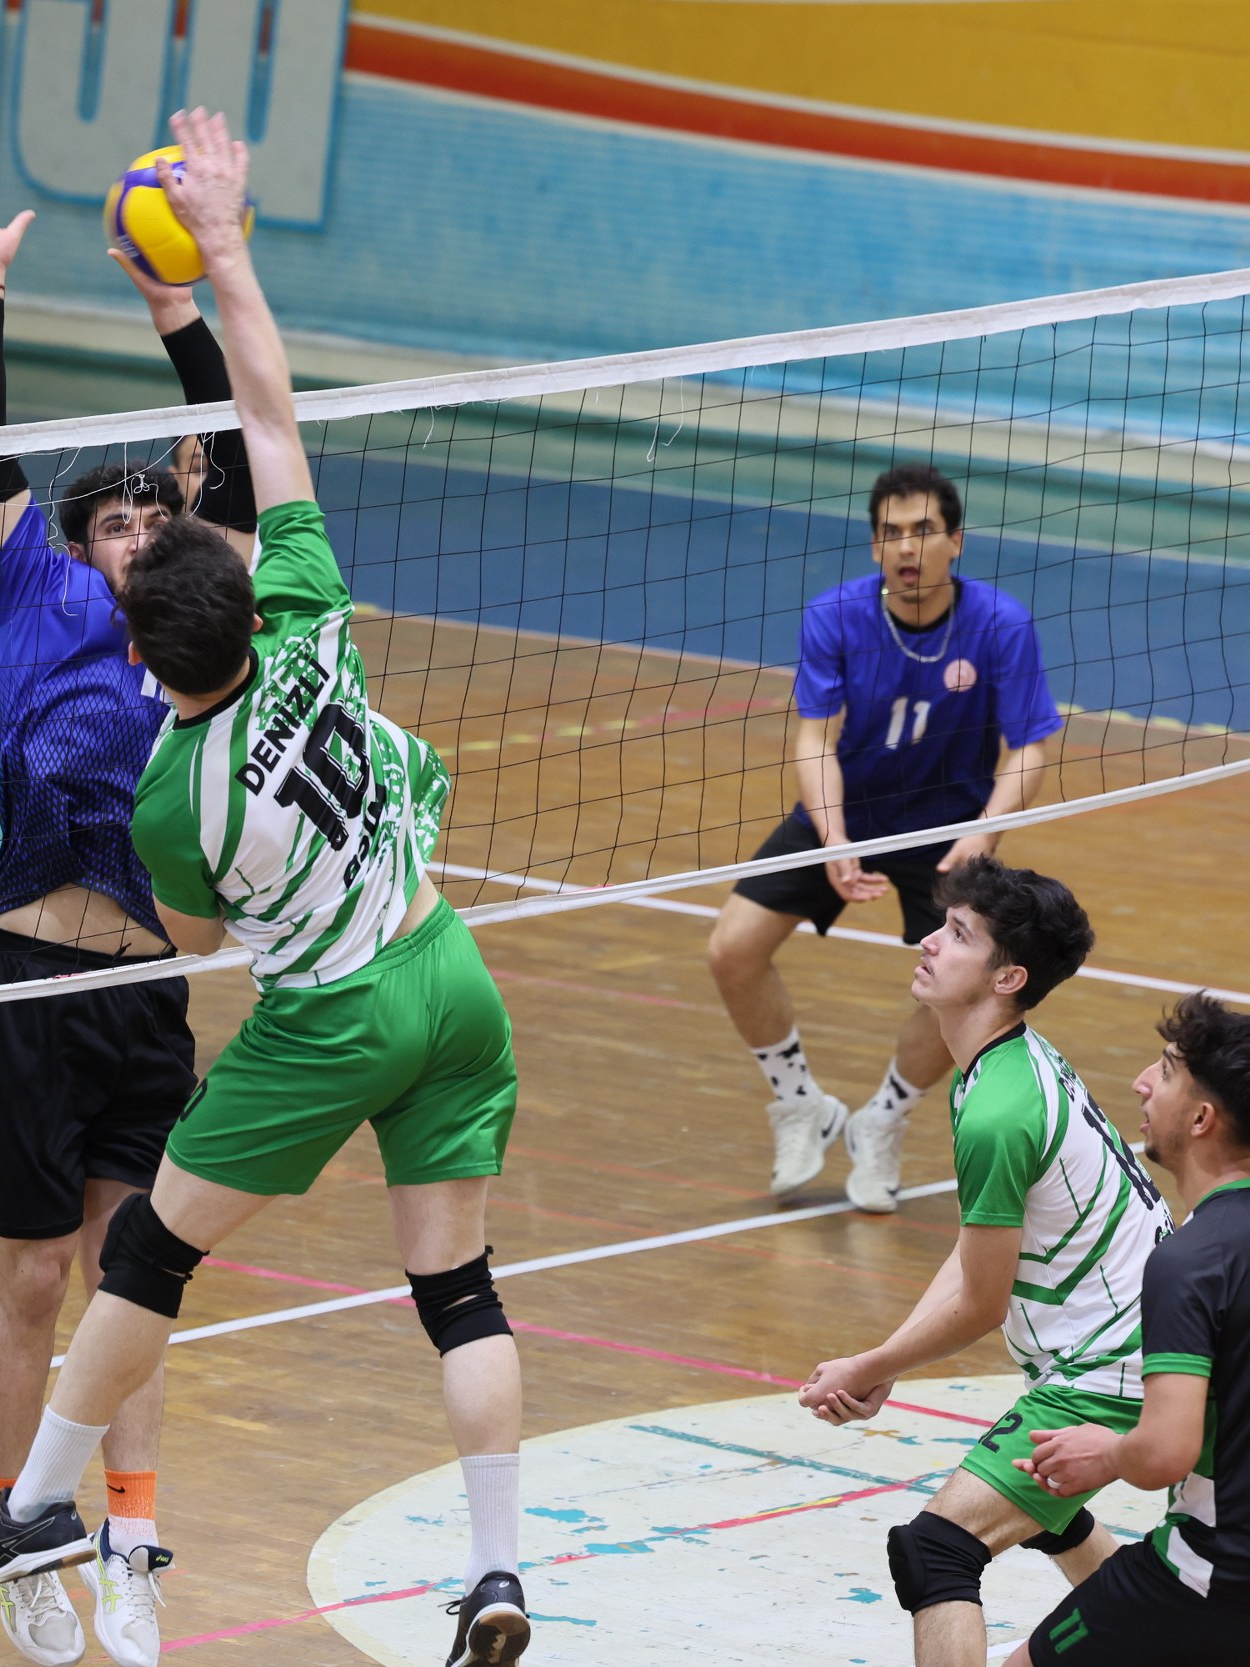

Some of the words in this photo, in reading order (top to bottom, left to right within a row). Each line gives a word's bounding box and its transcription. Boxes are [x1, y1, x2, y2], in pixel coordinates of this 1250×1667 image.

[234, 652, 330, 797] DENİZLİ
[884, 697, 931, 750] 11
[273, 702, 370, 852] 10
[1049, 1607, 1089, 1655] 11
